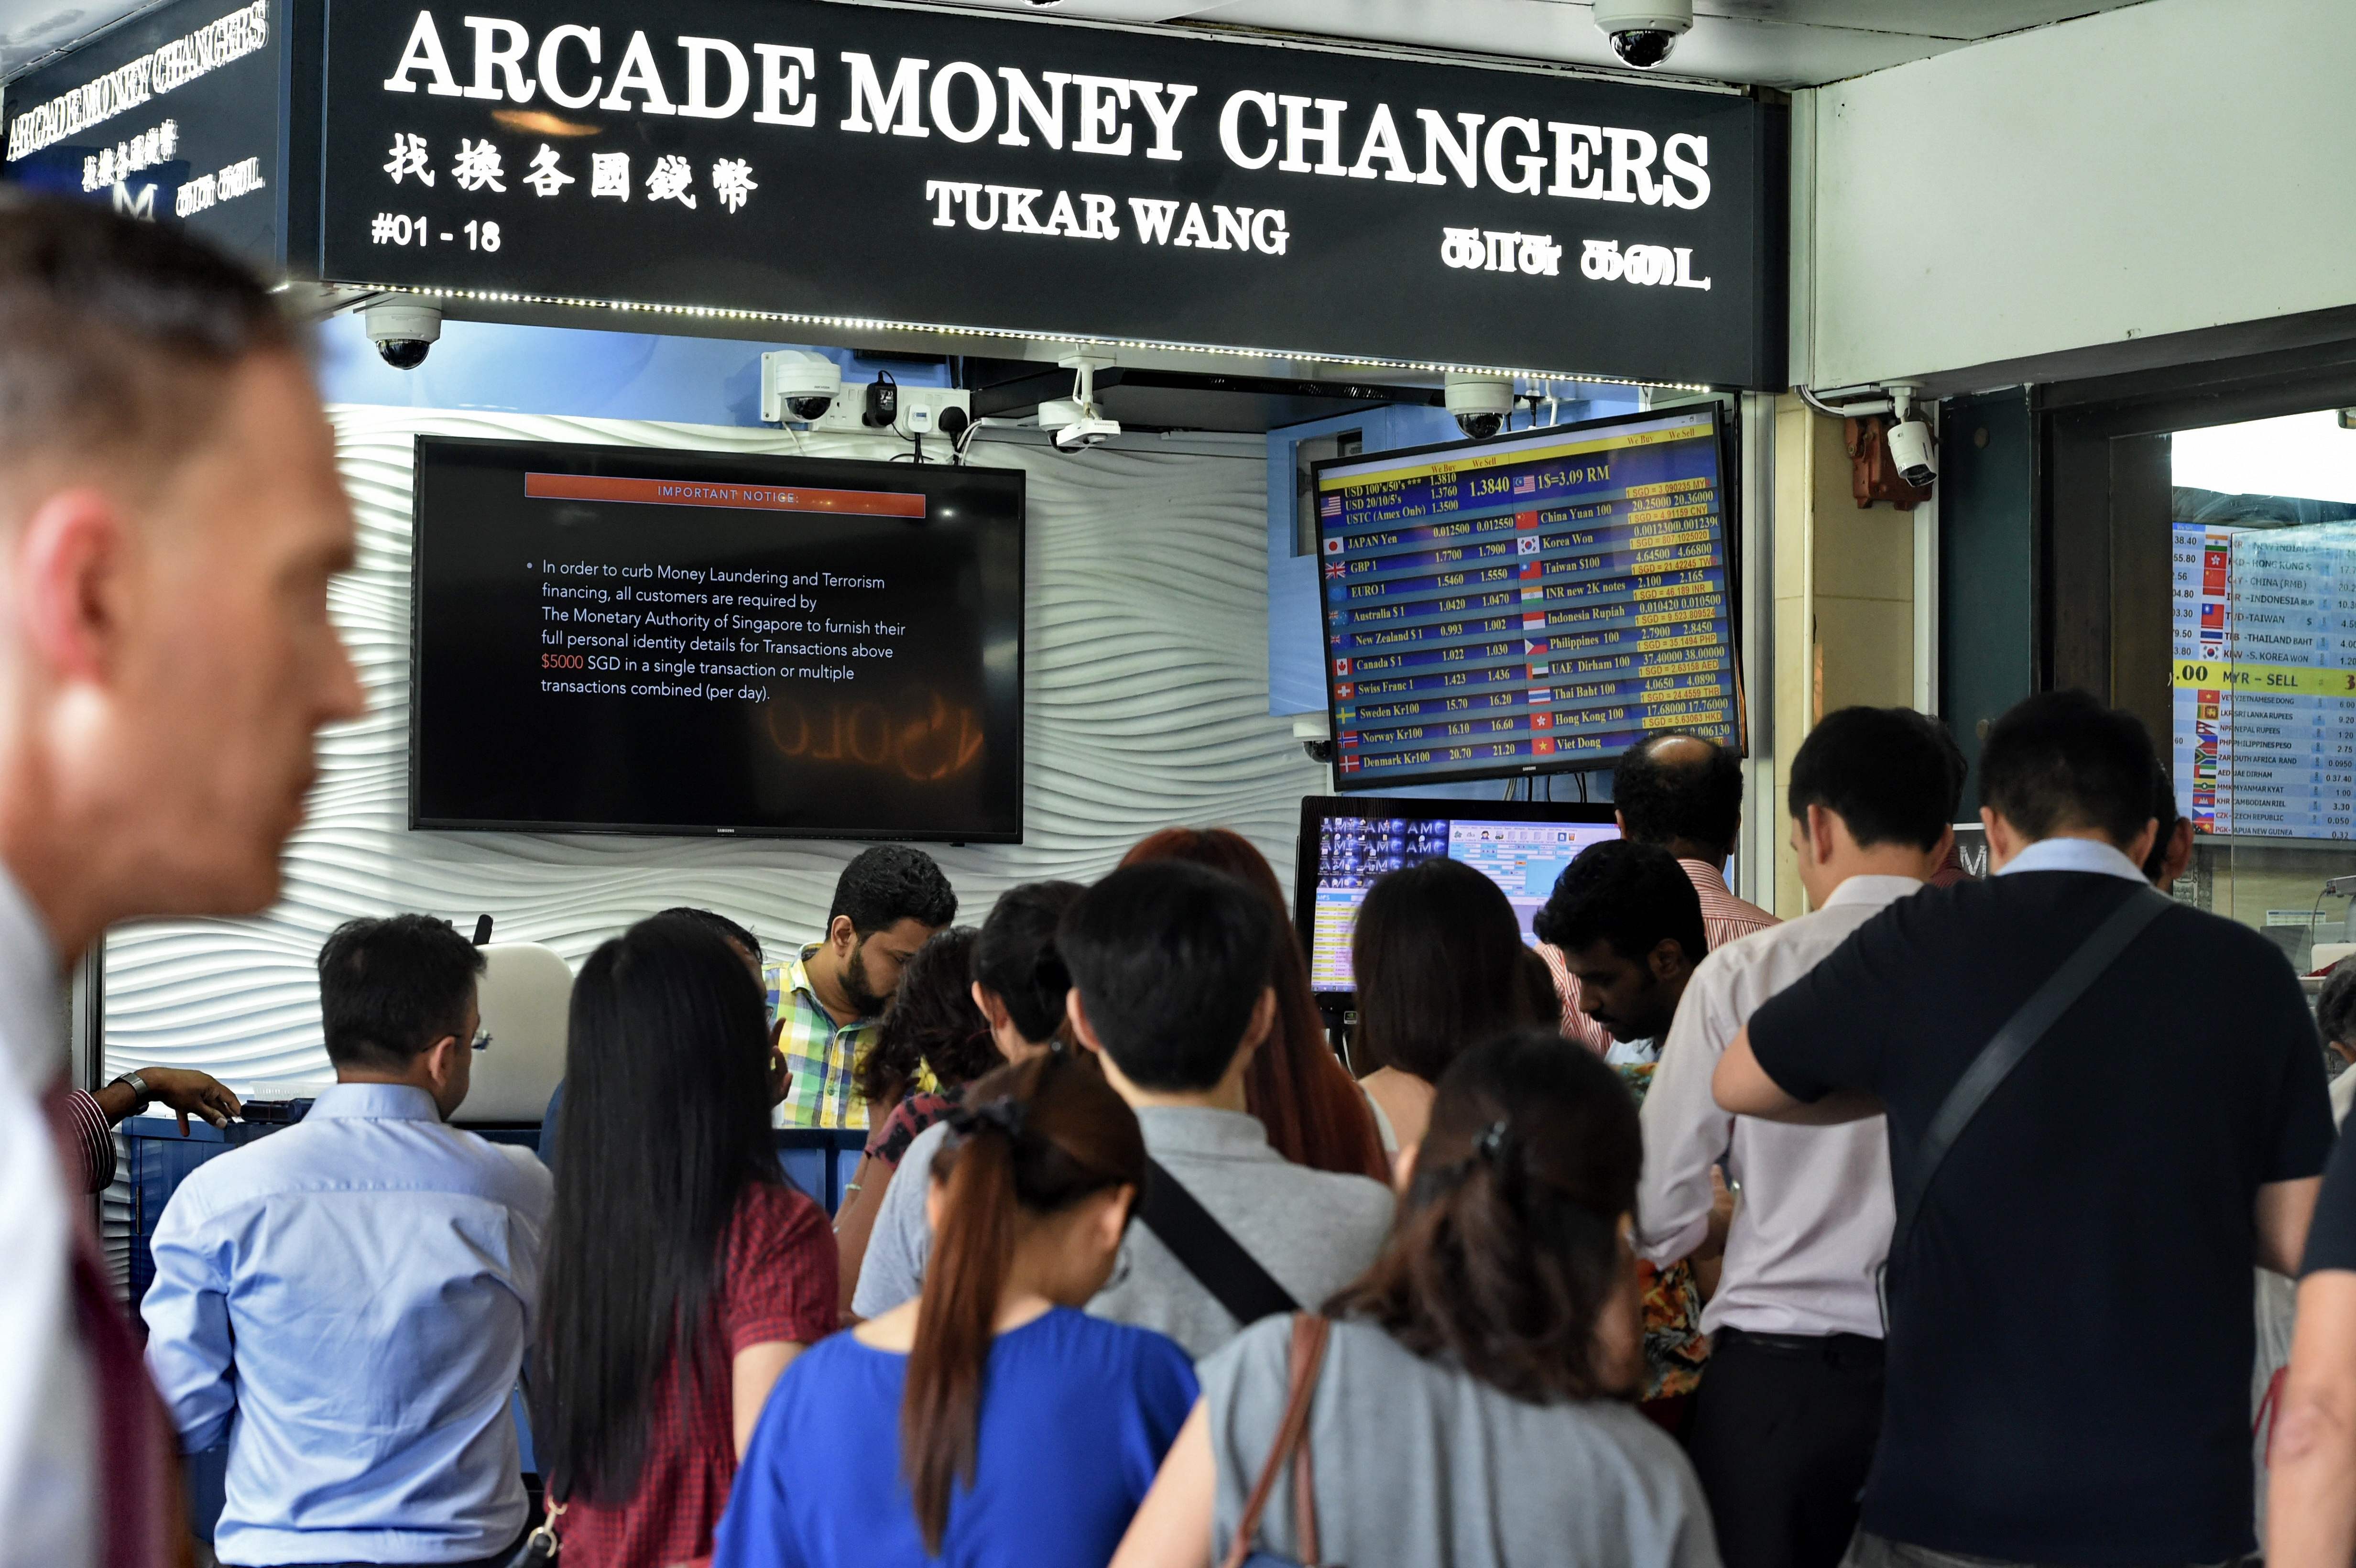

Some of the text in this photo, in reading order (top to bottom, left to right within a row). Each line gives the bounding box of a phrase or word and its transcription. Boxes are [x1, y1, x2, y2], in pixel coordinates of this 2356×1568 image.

[384, 10, 1711, 210] ARCADE MONEY CHANGERS
[926, 180, 1290, 256] TUKAR WANG
[371, 212, 427, 247] #01
[464, 220, 501, 252] 18
[1344, 472, 1456, 498] USD 1.3810
[1587, 465, 1610, 482] RM
[658, 486, 737, 500] IMPORTANT
[1470, 476, 1509, 496] 1.3840
[1345, 499, 1364, 511] USD
[1431, 486, 1457, 499] 1.3760
[1346, 512, 1371, 524] USTC
[1432, 500, 1458, 513] 1.3500
[1540, 504, 1612, 523] China Yuan 100
[1348, 517, 1514, 549] JAPAN Yen 0.012500 0.012550
[1543, 534, 1593, 549] Korea Won
[1351, 544, 1506, 573] GBP 1.7700 1.7900
[1544, 557, 1600, 574] Taiwan $100
[543, 559, 884, 588] In order to curb Money Laundering and Terrorism
[1352, 569, 1507, 598] EURO 1.5460 1.5550
[2250, 577, 2307, 590] CHINA (RMB)
[542, 582, 817, 612] financing, all customers are required by
[1546, 582, 1625, 599] INR new 2K notes
[1353, 594, 1509, 621] Australia 1.0420 1.0470
[1548, 605, 1625, 624] Indonesia Rupiah
[542, 606, 905, 635] The Monetary Authority of Singapore to furnish their
[1356, 619, 1506, 645] New Zealand 0.993 1.002
[541, 629, 893, 658] full personal identity details for Transactions above
[1550, 632, 1619, 651] Philippines 100
[542, 653, 854, 683] $5000 SGD in a single transaction or multiple
[1356, 644, 1508, 670] Canada 1.022 1.030
[1552, 656, 1630, 674] UAE Dirham 100
[2260, 653, 2308, 663] KOREA WON
[541, 679, 770, 703] transactions combined (per day).
[1358, 669, 1510, 694] Swiss Franc 1.423 1.436
[1553, 684, 1615, 699] Thai Baht 100
[2267, 674, 2298, 687] SELL
[1360, 694, 1512, 718] Sweden Kr100 15.70 16.20
[1556, 708, 1624, 726] Hong Kong 100
[1363, 719, 1514, 744] Norway Kr100 16.10 16.60
[1557, 737, 1601, 750] Viet Dong
[1363, 744, 1515, 767] Denmark Kr100 20.70 21.20
